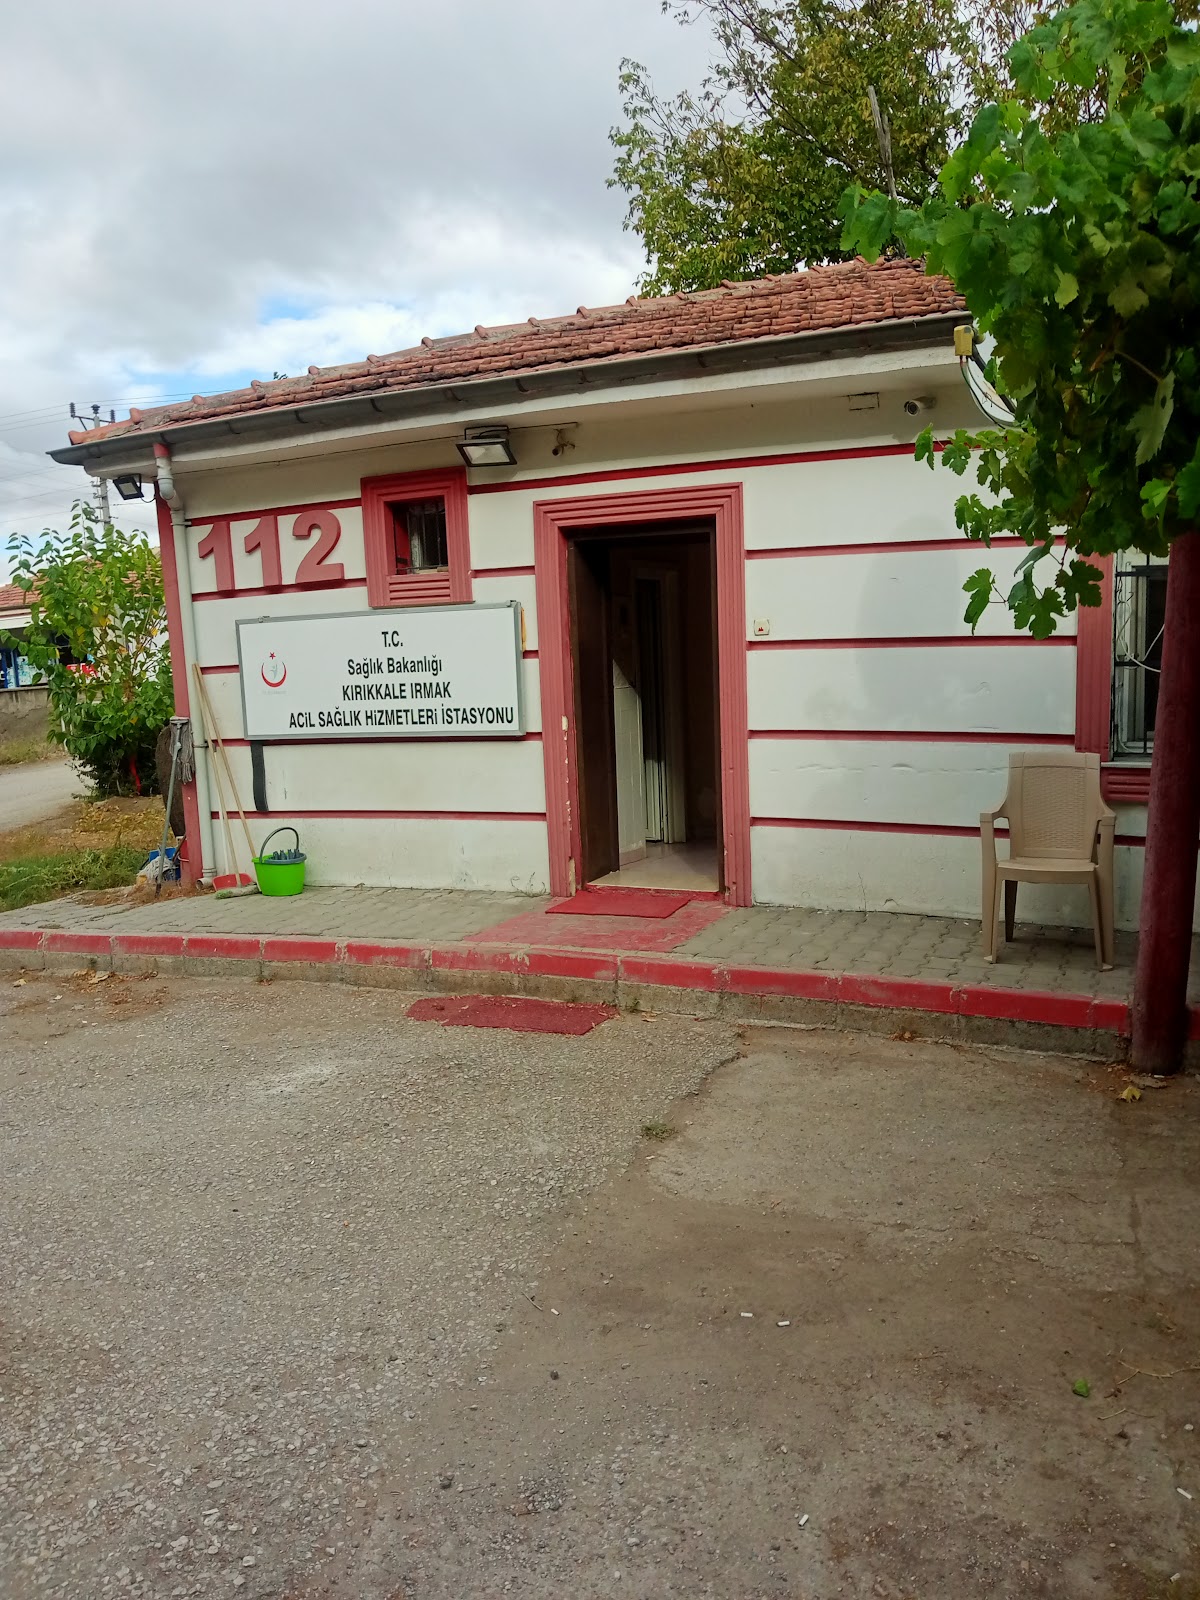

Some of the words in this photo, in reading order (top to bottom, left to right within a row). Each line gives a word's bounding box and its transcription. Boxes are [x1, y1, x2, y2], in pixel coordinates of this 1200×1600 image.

[198, 510, 344, 591] 112
[381, 630, 403, 648] T.C.
[347, 657, 384, 679] Sağlık
[387, 654, 442, 676] Bakanlığı
[342, 682, 407, 701] KIRIKKALE
[410, 681, 452, 699] IRMAK
[318, 705, 362, 728] SAĞLIK
[441, 703, 514, 725] İSTASYONU
